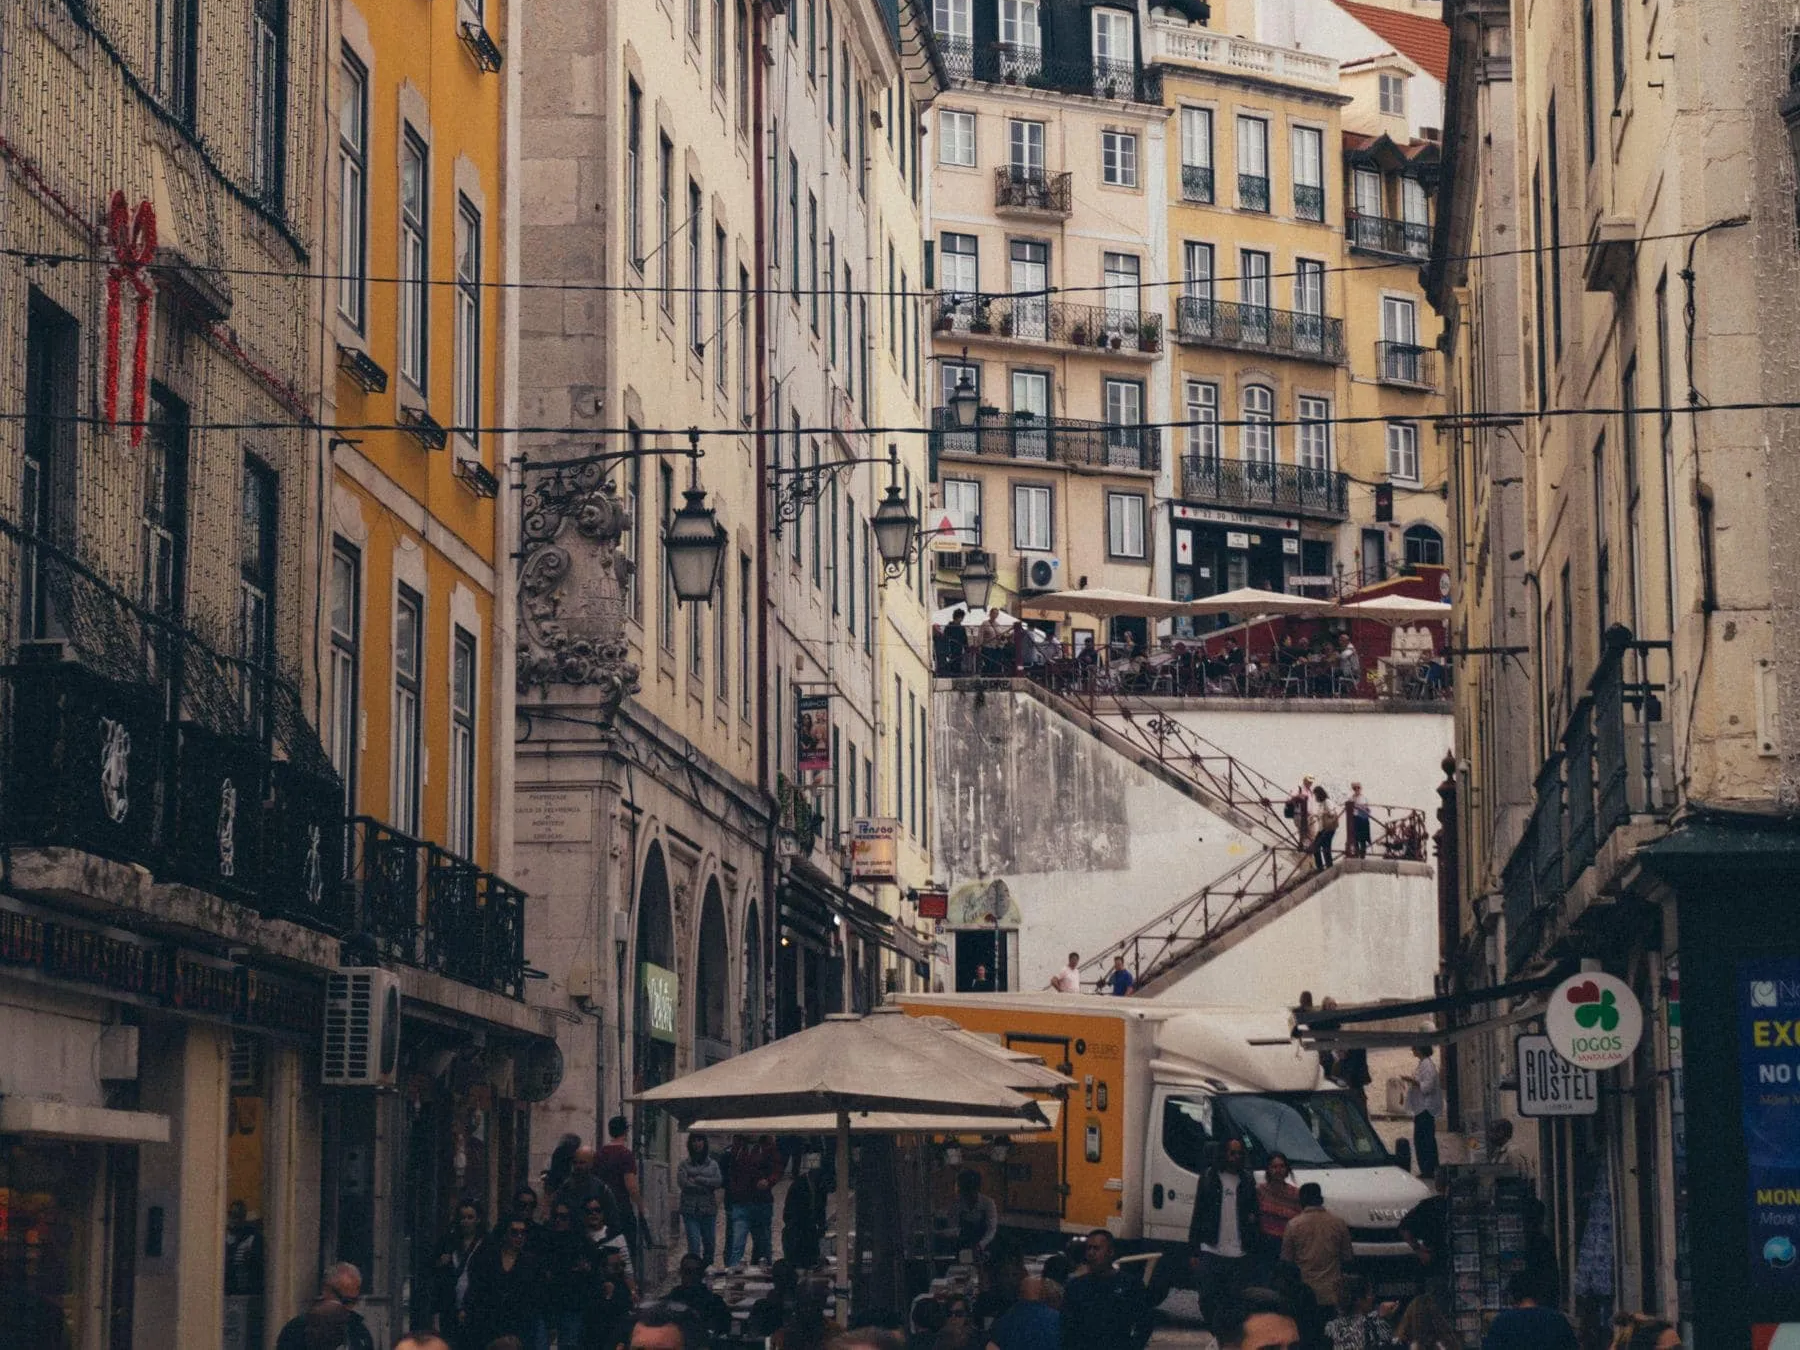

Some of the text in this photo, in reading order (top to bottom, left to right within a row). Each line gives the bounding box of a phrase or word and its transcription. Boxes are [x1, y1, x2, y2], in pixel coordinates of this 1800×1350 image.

[1572, 1036, 1622, 1057] JOGOS
[1759, 1063, 1791, 1083] NO
[1527, 1074, 1595, 1102] HOSTEL
